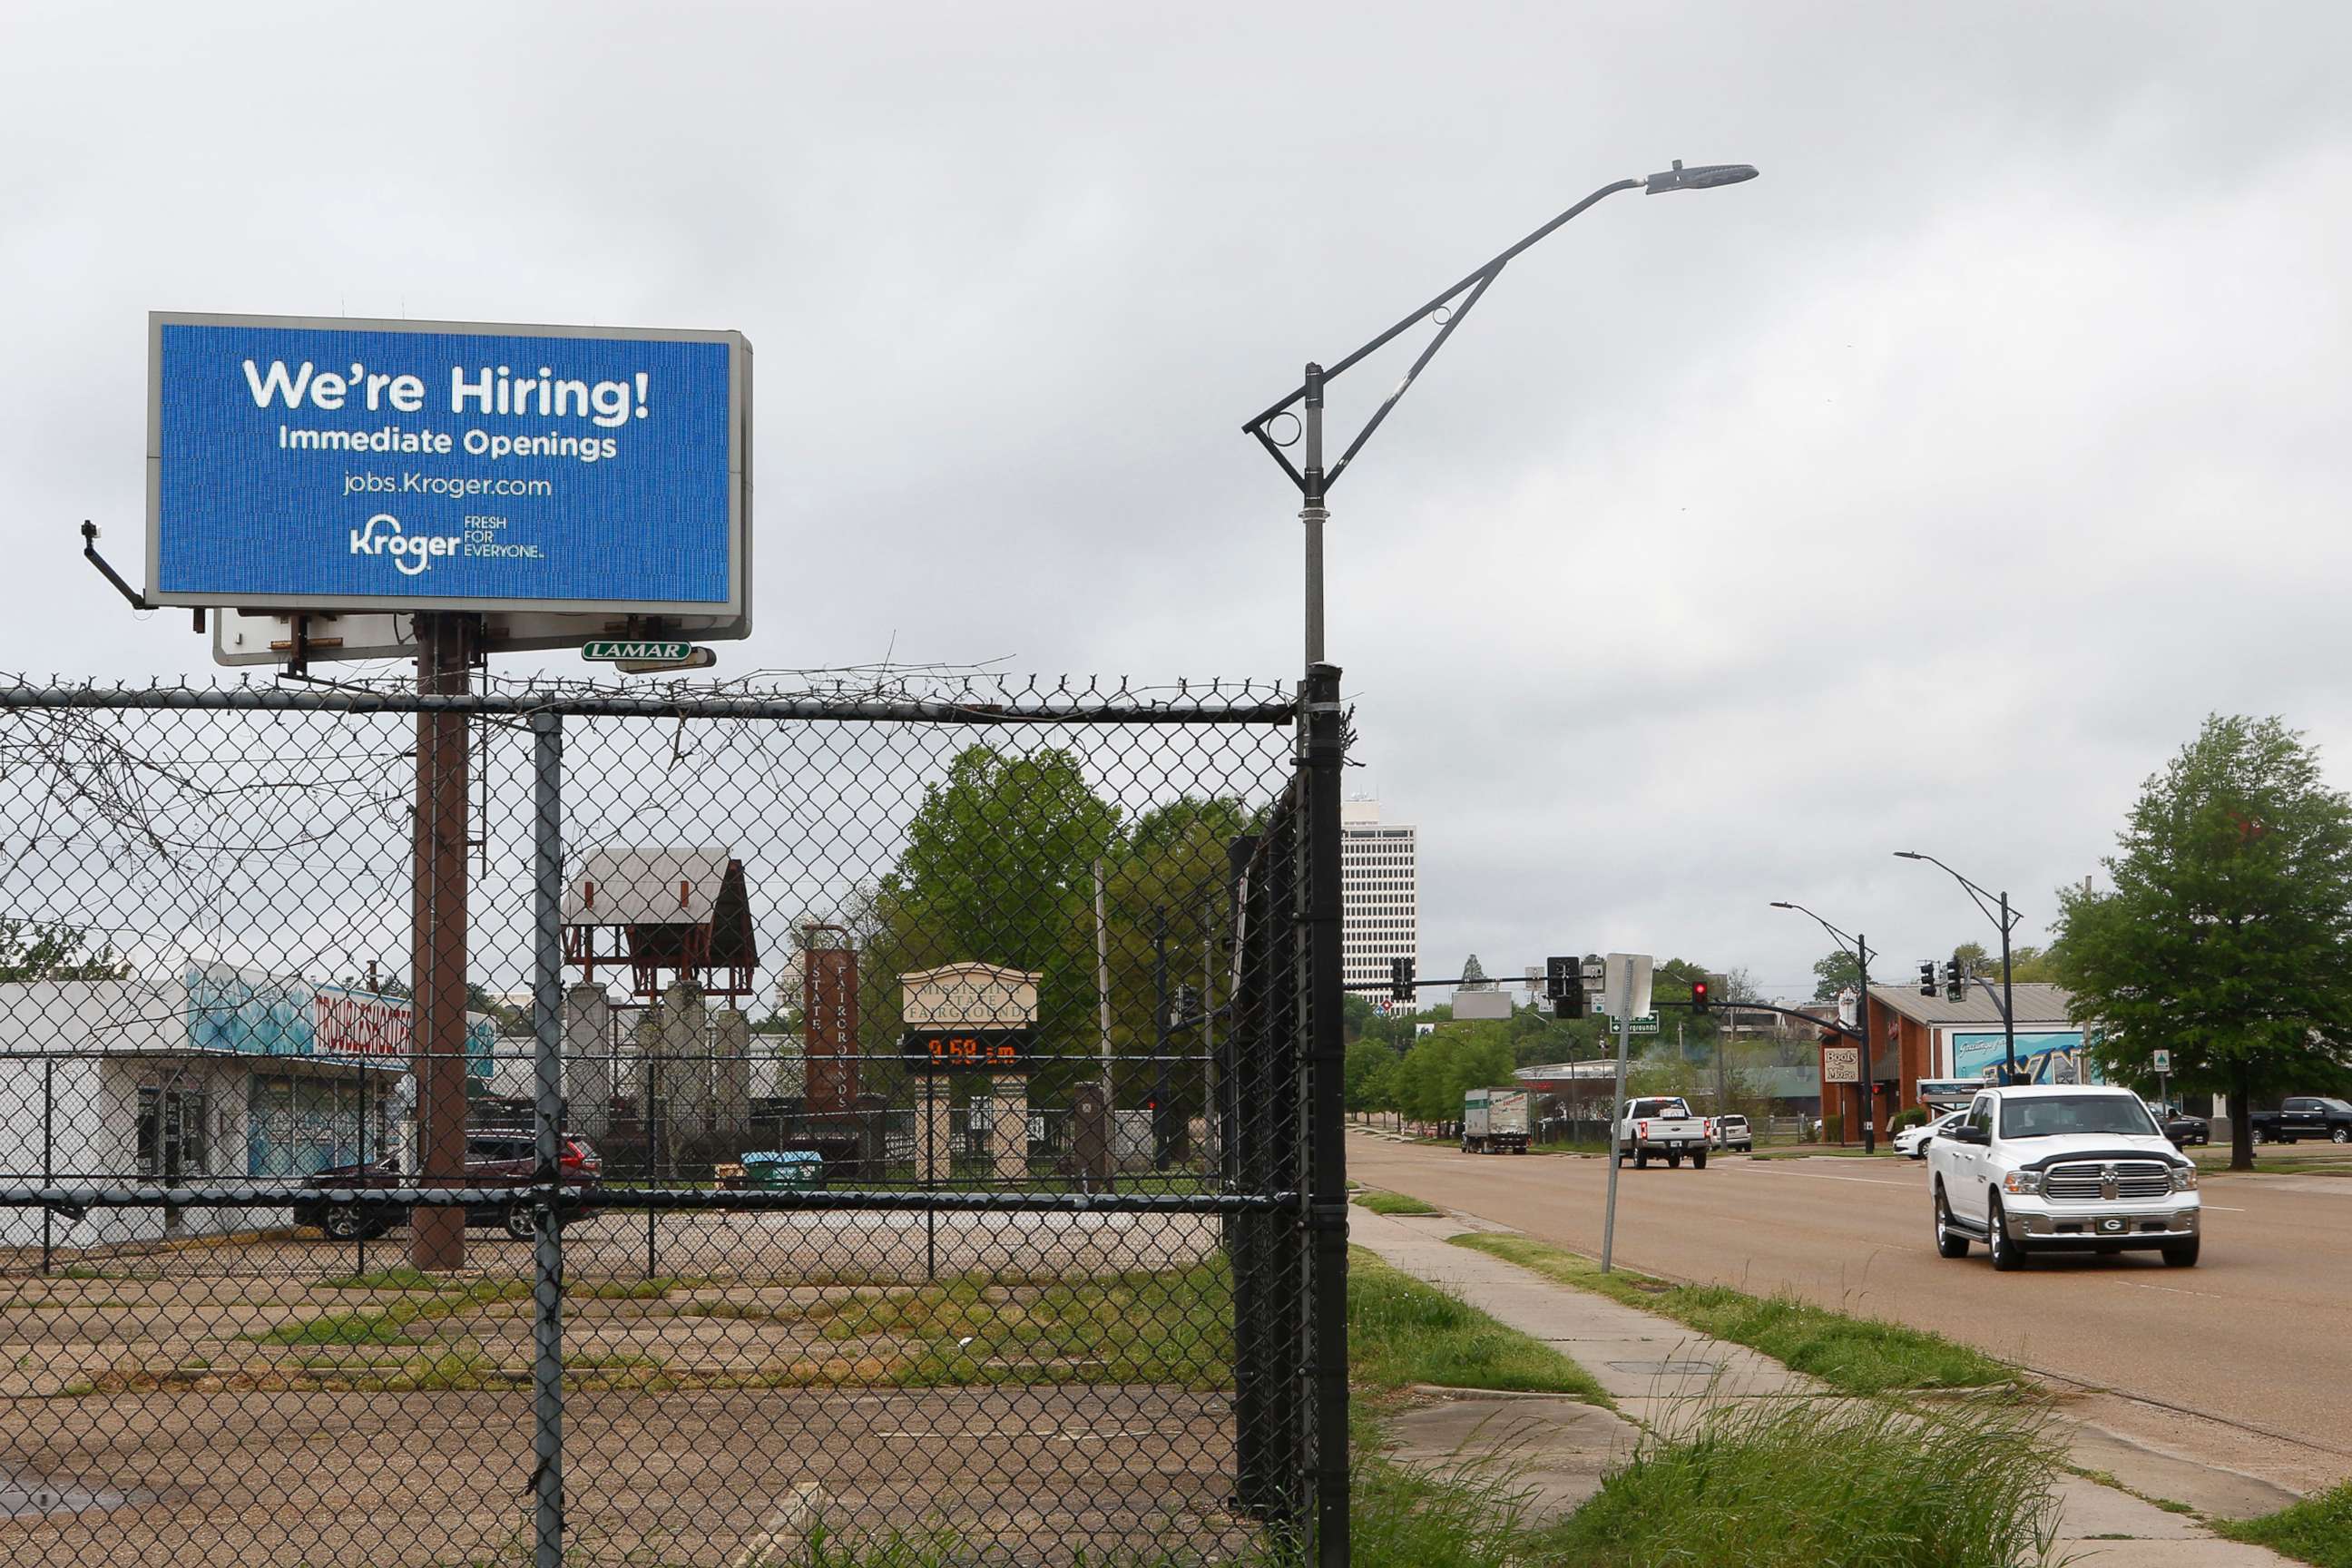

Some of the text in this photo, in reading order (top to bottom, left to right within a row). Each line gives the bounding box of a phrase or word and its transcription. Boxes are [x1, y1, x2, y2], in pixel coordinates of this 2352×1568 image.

[242, 359, 649, 427] We’re Hiring!
[279, 425, 617, 463] Immediate Openings
[342, 470, 552, 498] jobs.Kroger.com
[465, 515, 507, 530] FRESH
[465, 530, 494, 543] FOR
[350, 514, 461, 575] Kroger
[591, 643, 681, 657] LAMAR
[920, 984, 1021, 995] MISSISSIPPI
[812, 967, 821, 1030] STATE
[945, 995, 997, 1006] STATE
[909, 1006, 1032, 1018] FAIRGROUNDS
[837, 966, 848, 1107] FAIRGROUNDS
[1827, 1050, 1857, 1064] Boots
[1828, 1068, 1857, 1079] More
[2104, 1219, 2122, 1230] G
